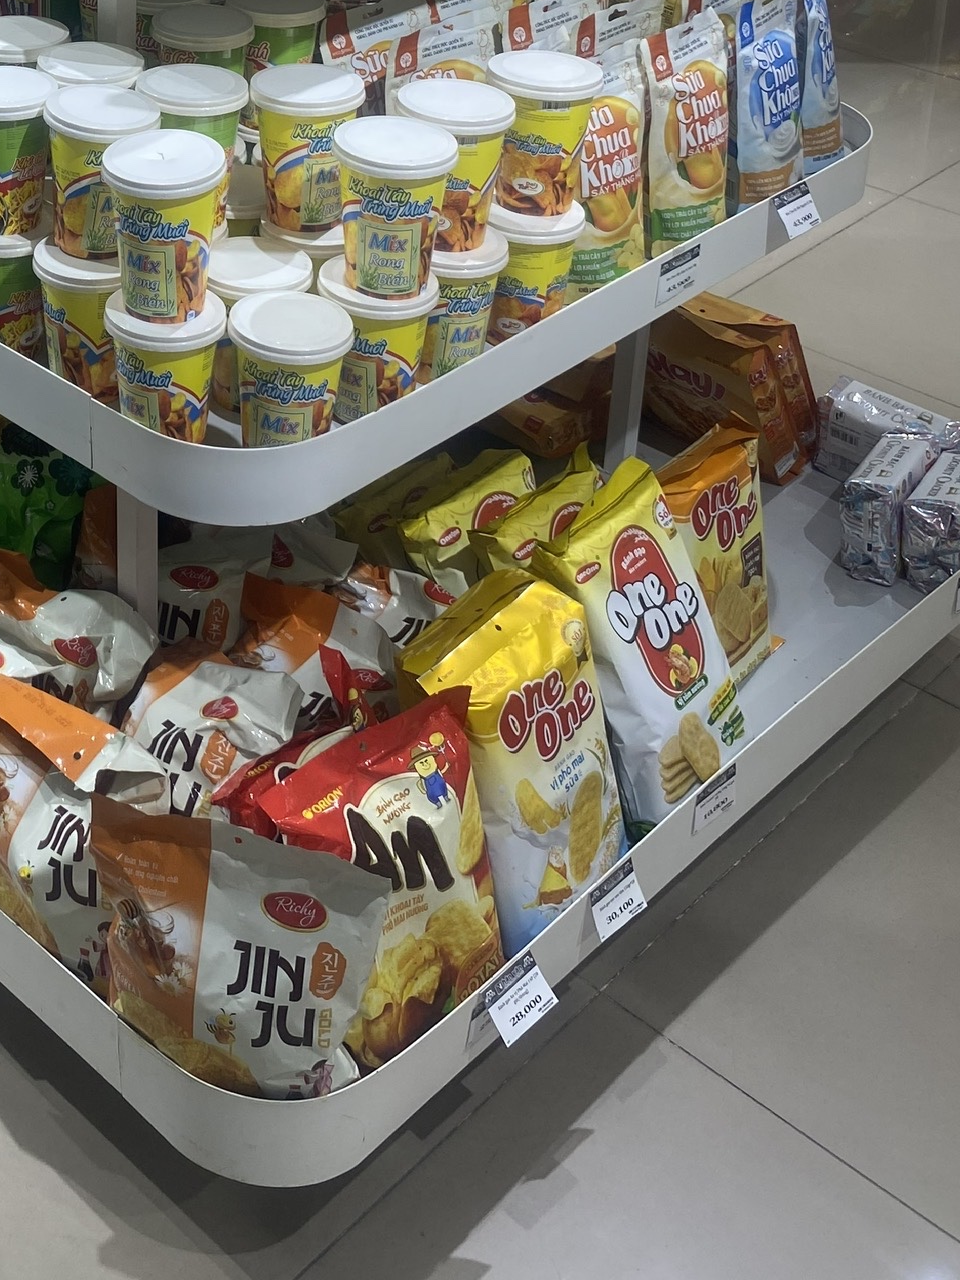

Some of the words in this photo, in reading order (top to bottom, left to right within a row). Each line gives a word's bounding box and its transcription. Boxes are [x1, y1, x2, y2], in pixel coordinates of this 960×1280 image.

[754, 39, 784, 71] Sữa
[671, 70, 706, 102] Sữa
[759, 60, 797, 91] Chua
[675, 91, 722, 125] Chua
[348, 176, 385, 204] Khoai
[581, 158, 624, 198] Khô
[154, 219, 190, 240] Muối
[367, 233, 407, 253] Mix
[127, 249, 161, 273] Mix
[368, 252, 405, 273] Rong
[377, 269, 411, 287] Biển
[691, 475, 741, 542] One
[715, 486, 759, 553] One
[606, 572, 667, 644] One
[643, 582, 699, 651] One
[497, 668, 565, 753] One
[539, 677, 596, 762] One
[311, 784, 343, 815] ORION
[274, 895, 317, 927] Richy
[606, 897, 635, 926] 30,100
[227, 939, 307, 1003] JIN
[317, 951, 340, 995] 진주
[250, 1002, 316, 1049] JU
[509, 993, 543, 1028] 28,000
[317, 1007, 333, 1049] GOLD
